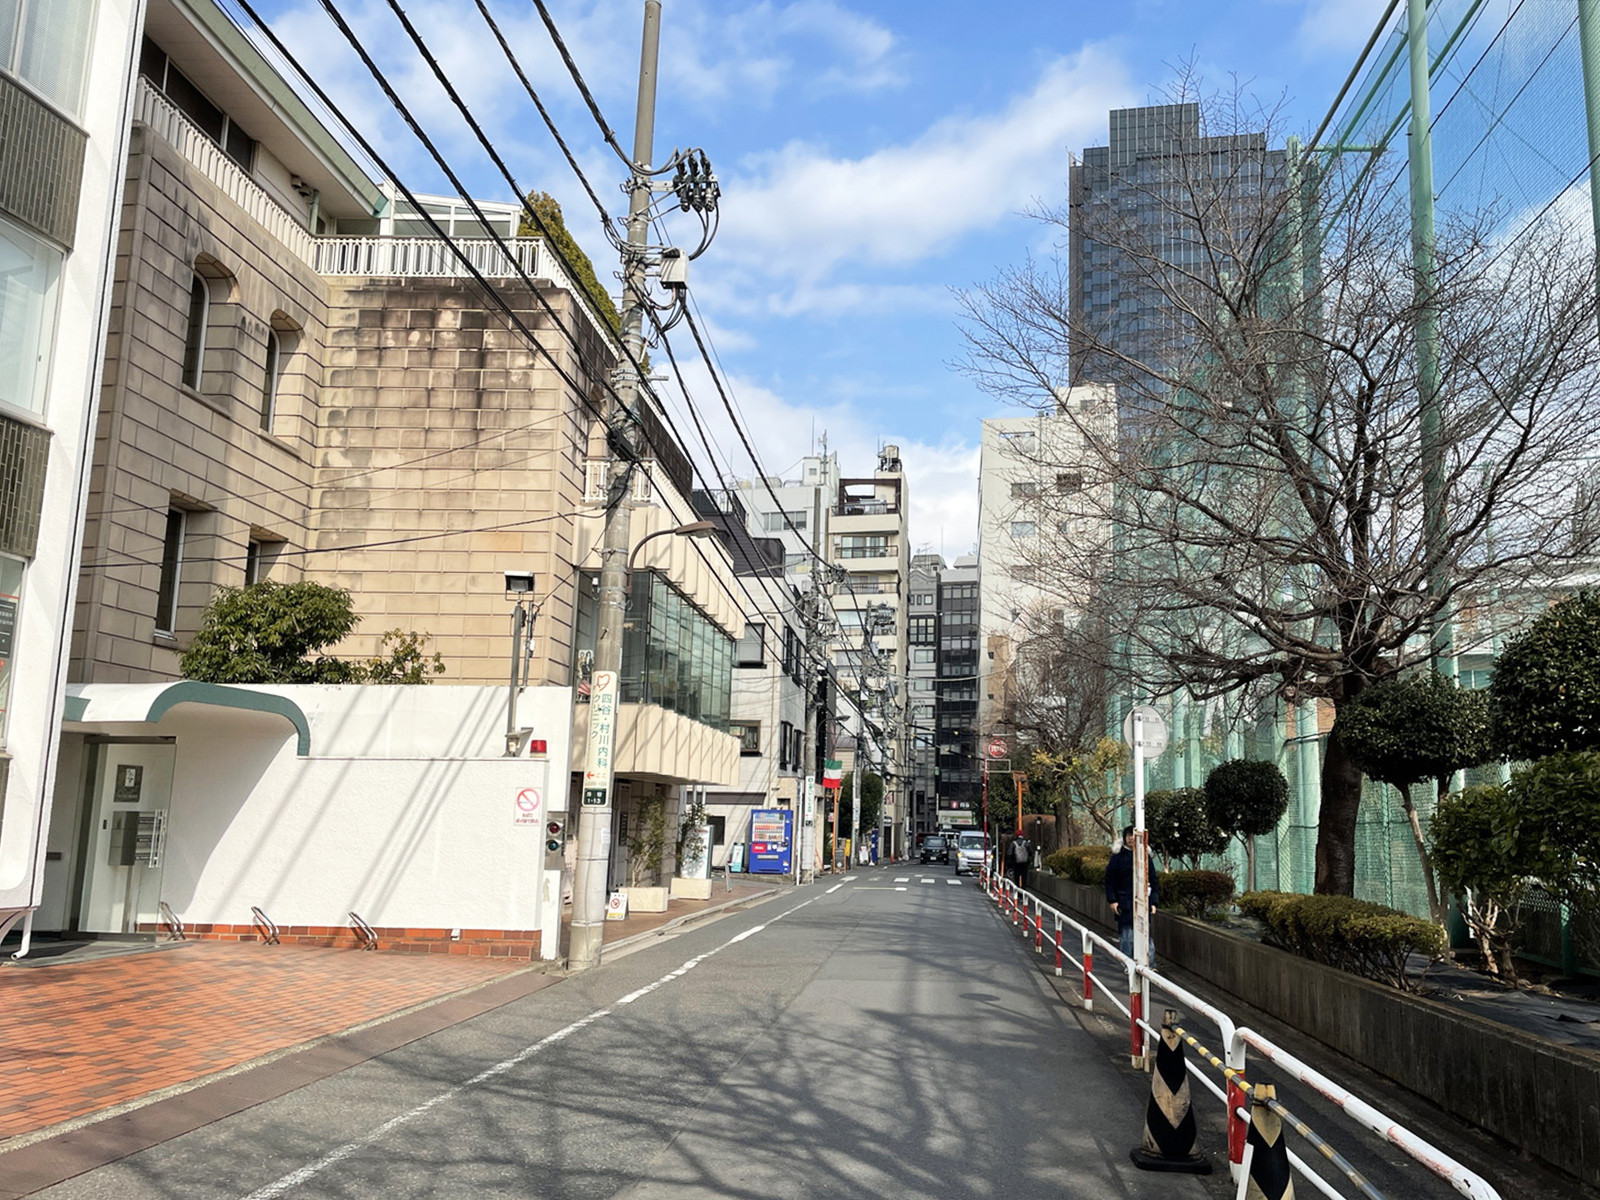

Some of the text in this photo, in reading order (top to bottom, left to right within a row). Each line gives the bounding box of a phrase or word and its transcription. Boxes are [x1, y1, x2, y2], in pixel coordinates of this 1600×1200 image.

[591, 694, 601, 740] クリニック
[597, 693, 612, 769] 四谷・村川内科
